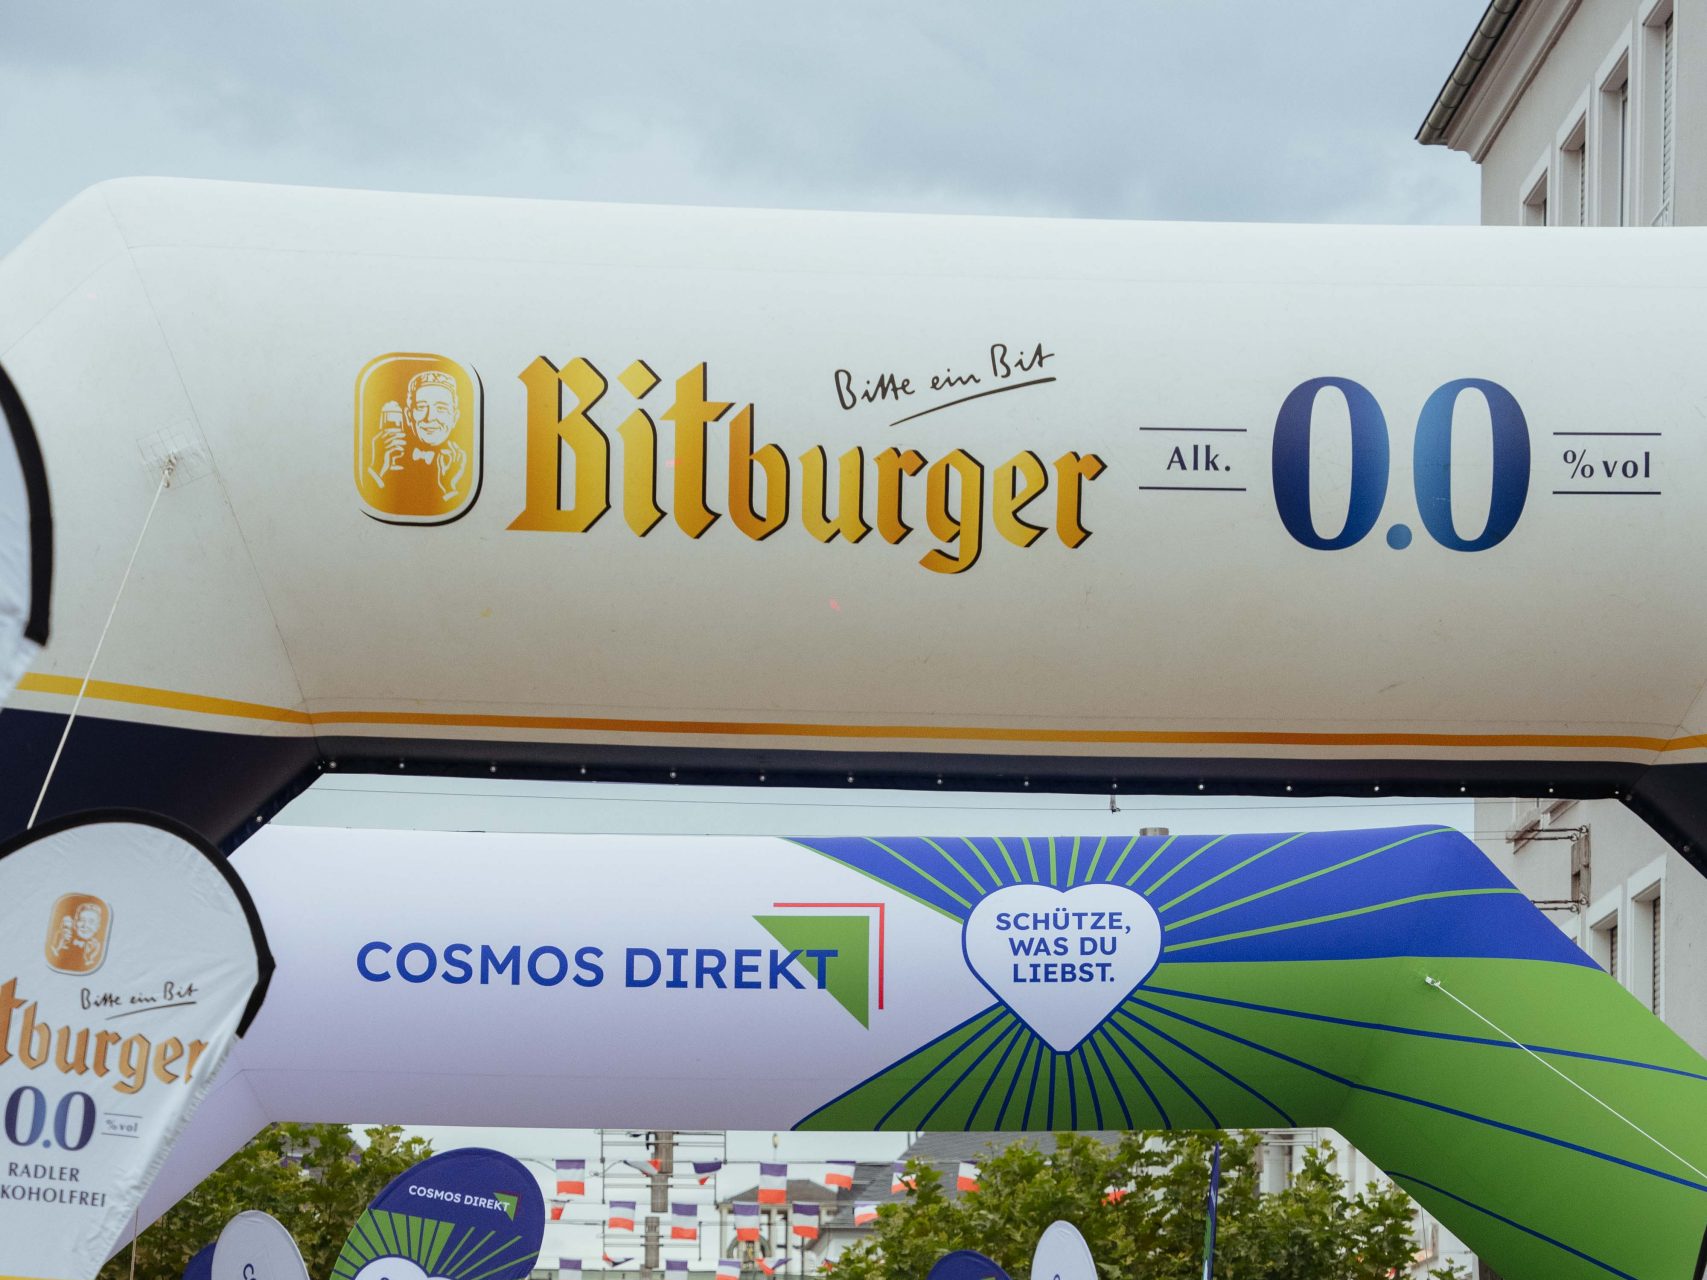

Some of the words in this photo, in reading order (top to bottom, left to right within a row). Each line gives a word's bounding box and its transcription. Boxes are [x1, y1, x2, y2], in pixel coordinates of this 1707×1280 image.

[834, 368, 916, 411] Bitte
[930, 367, 981, 391] ein
[990, 343, 1055, 379] Bit
[506, 355, 1108, 574] Bitburger
[1166, 444, 1231, 472] Alk.
[1272, 376, 1531, 552] 0.0
[996, 907, 1131, 934] SCHÜTZE,
[1008, 937, 1069, 956] WAS
[1080, 936, 1117, 956] DU
[356, 941, 604, 988] COSMOS
[625, 947, 838, 990] DIREKT
[1013, 962, 1115, 983] LIEBST.
[81, 988, 121, 1010] Bitte
[164, 981, 198, 1000] Bit
[4, 1085, 96, 1151] 0.0
[8, 1162, 79, 1182] RADLER
[408, 1184, 462, 1203] COSMOS
[464, 1195, 511, 1213] DIREKT
